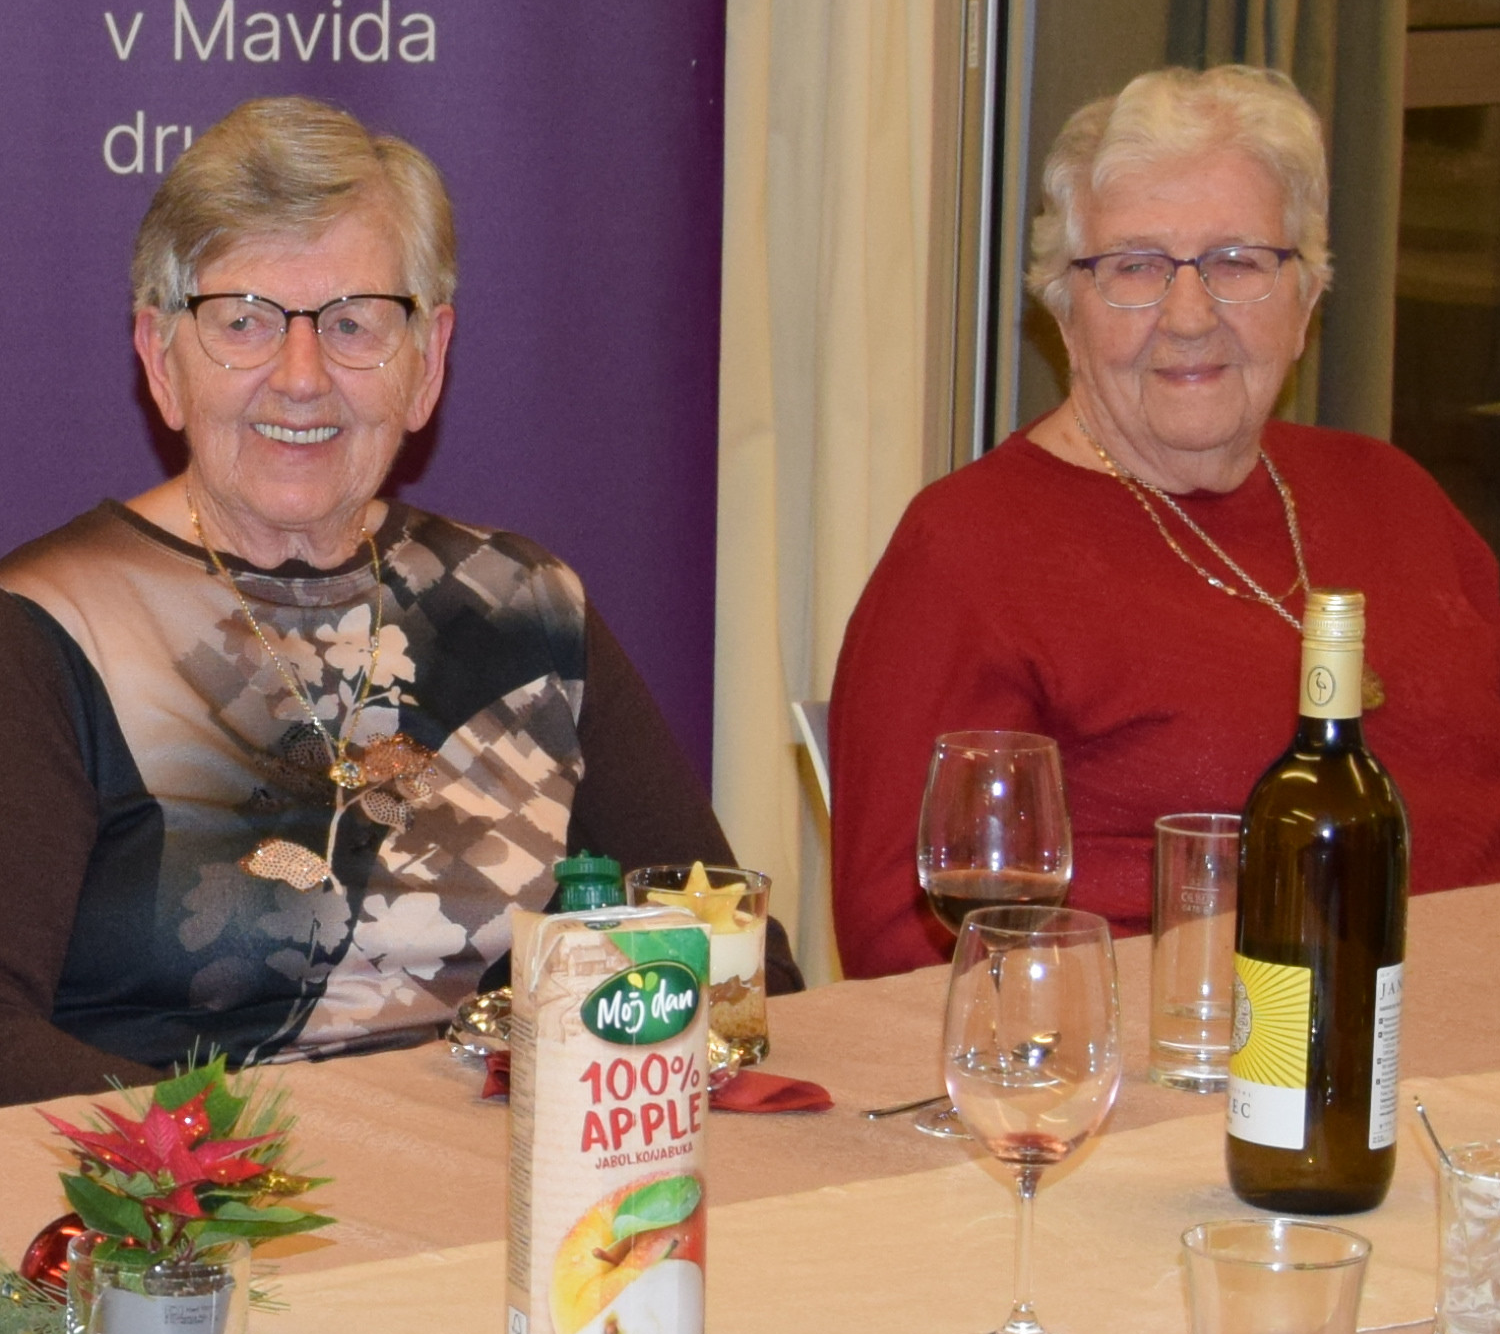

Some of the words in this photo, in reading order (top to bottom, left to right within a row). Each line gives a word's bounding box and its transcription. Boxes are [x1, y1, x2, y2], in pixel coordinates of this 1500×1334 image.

[105, 12, 143, 62] v
[103, 110, 192, 175] dr
[596, 989, 645, 1035] Moj
[650, 979, 694, 1024] dan
[579, 1052, 701, 1105] 100%
[580, 1091, 702, 1153] APPLE
